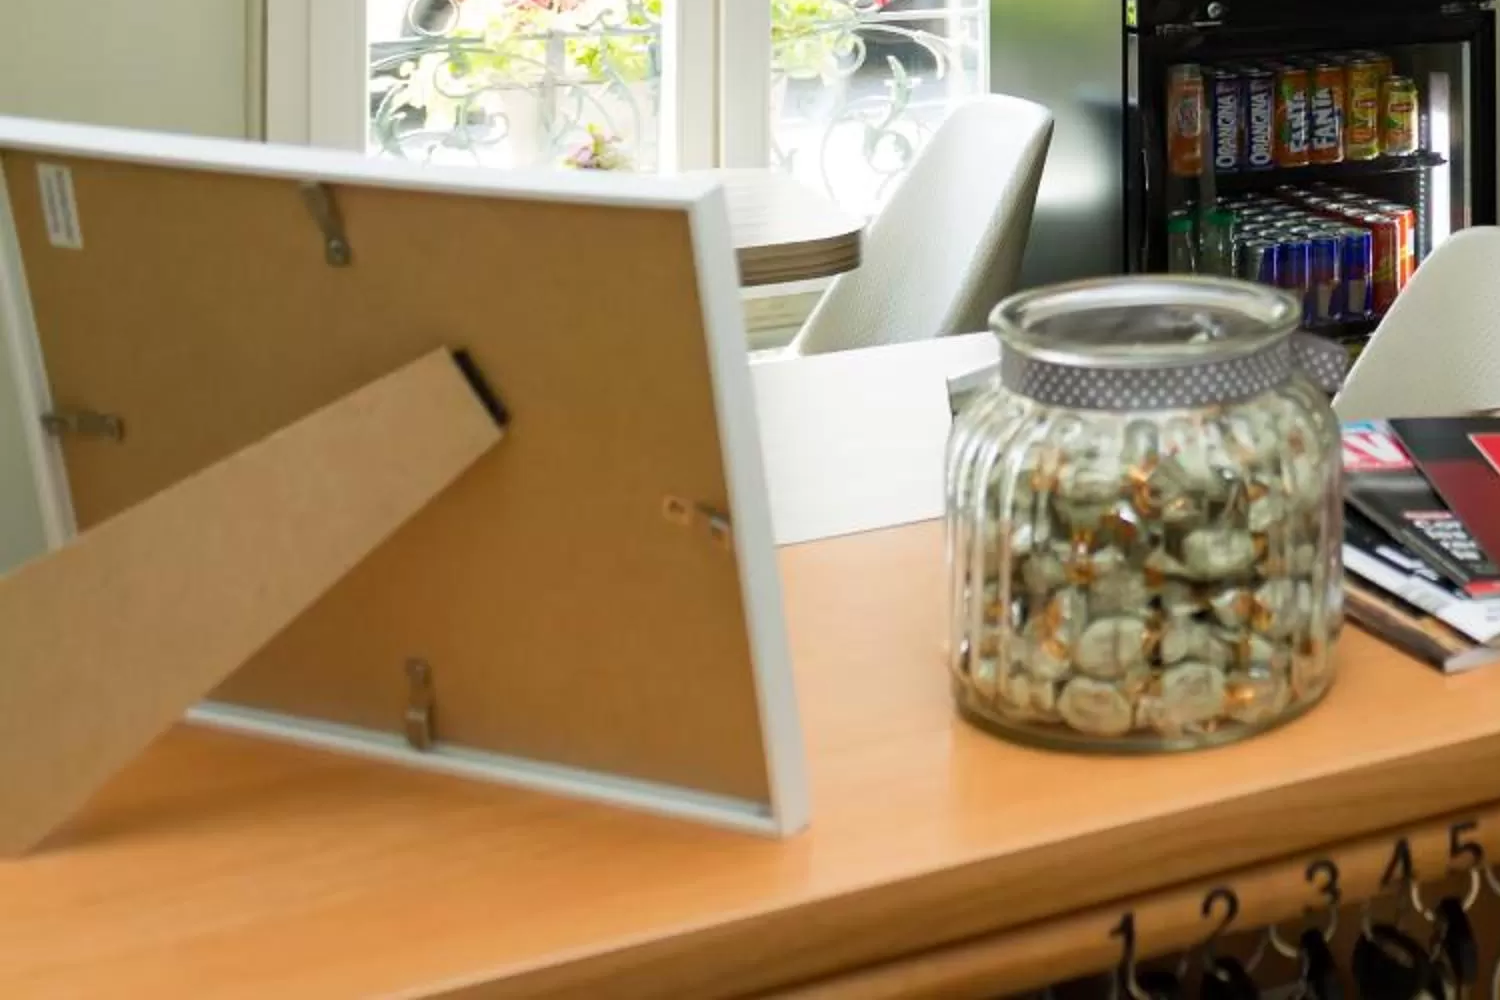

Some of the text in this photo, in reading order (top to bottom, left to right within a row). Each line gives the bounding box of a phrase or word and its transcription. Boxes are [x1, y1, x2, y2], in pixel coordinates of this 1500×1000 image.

[1202, 888, 1239, 932] 2
[1305, 859, 1341, 902] 3
[1448, 820, 1486, 868] 5
